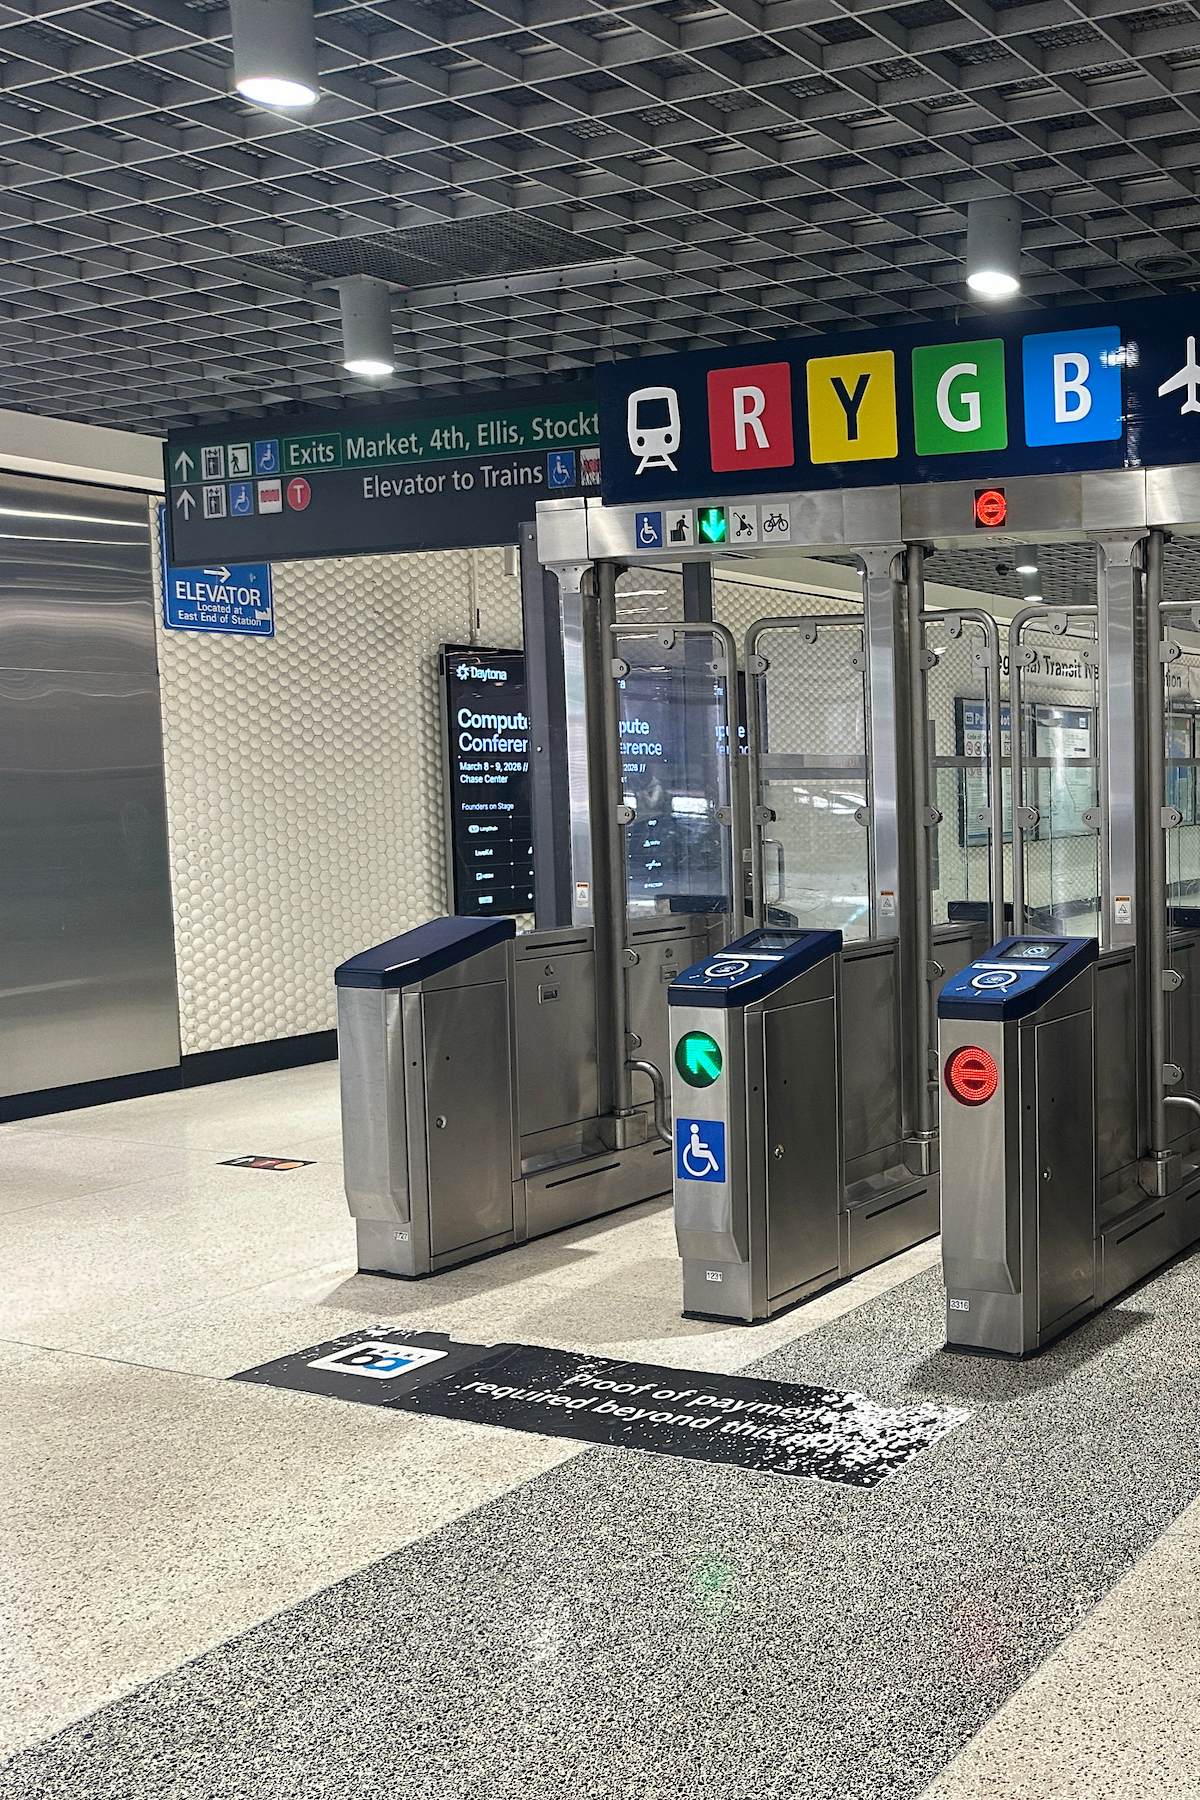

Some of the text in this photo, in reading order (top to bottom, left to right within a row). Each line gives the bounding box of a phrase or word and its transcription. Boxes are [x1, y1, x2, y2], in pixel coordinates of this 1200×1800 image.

[732, 352, 1092, 451] R Y G B
[290, 441, 335, 466] Exits
[346, 432, 424, 460] Market,
[430, 425, 471, 451] 4th,
[477, 420, 525, 447] Ellis,
[363, 462, 544, 499] Elevator to Trains
[175, 580, 262, 607] ELEVATOR
[197, 601, 243, 615] Located at
[178, 610, 262, 627] East End of Station
[470, 666, 508, 682] Daytona
[1043, 655, 1082, 678] Transit
[459, 762, 483, 771] March
[483, 762, 490, 771] 8
[494, 762, 503, 772] 9,
[503, 762, 522, 771] 2026
[459, 774, 508, 784] Chase Center
[461, 802, 489, 811] Founders
[497, 802, 515, 811] Stage
[951, 1300, 969, 1310] 3316
[652, 1388, 698, 1401] of
[462, 1381, 598, 1410] required
[591, 1399, 722, 1430] beyond
